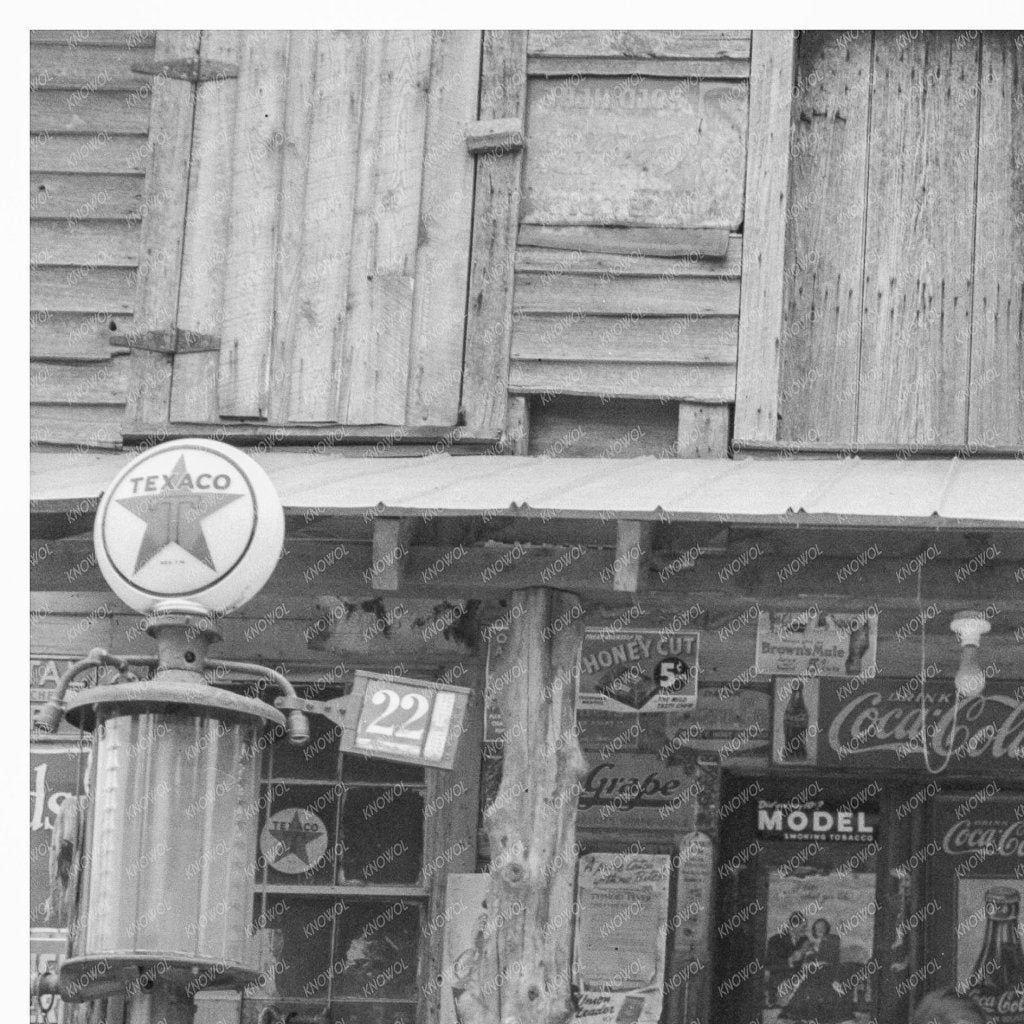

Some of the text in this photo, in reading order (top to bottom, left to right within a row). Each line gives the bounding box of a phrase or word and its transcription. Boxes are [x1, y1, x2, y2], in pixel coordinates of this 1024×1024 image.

[129, 473, 232, 494] TEXACO
[582, 637, 695, 674] HONEY CUT
[366, 689, 430, 740] 22
[583, 763, 681, 800] Grape
[757, 809, 874, 833] MODEL
[784, 833, 873, 842] SMOKING TOBACCO
